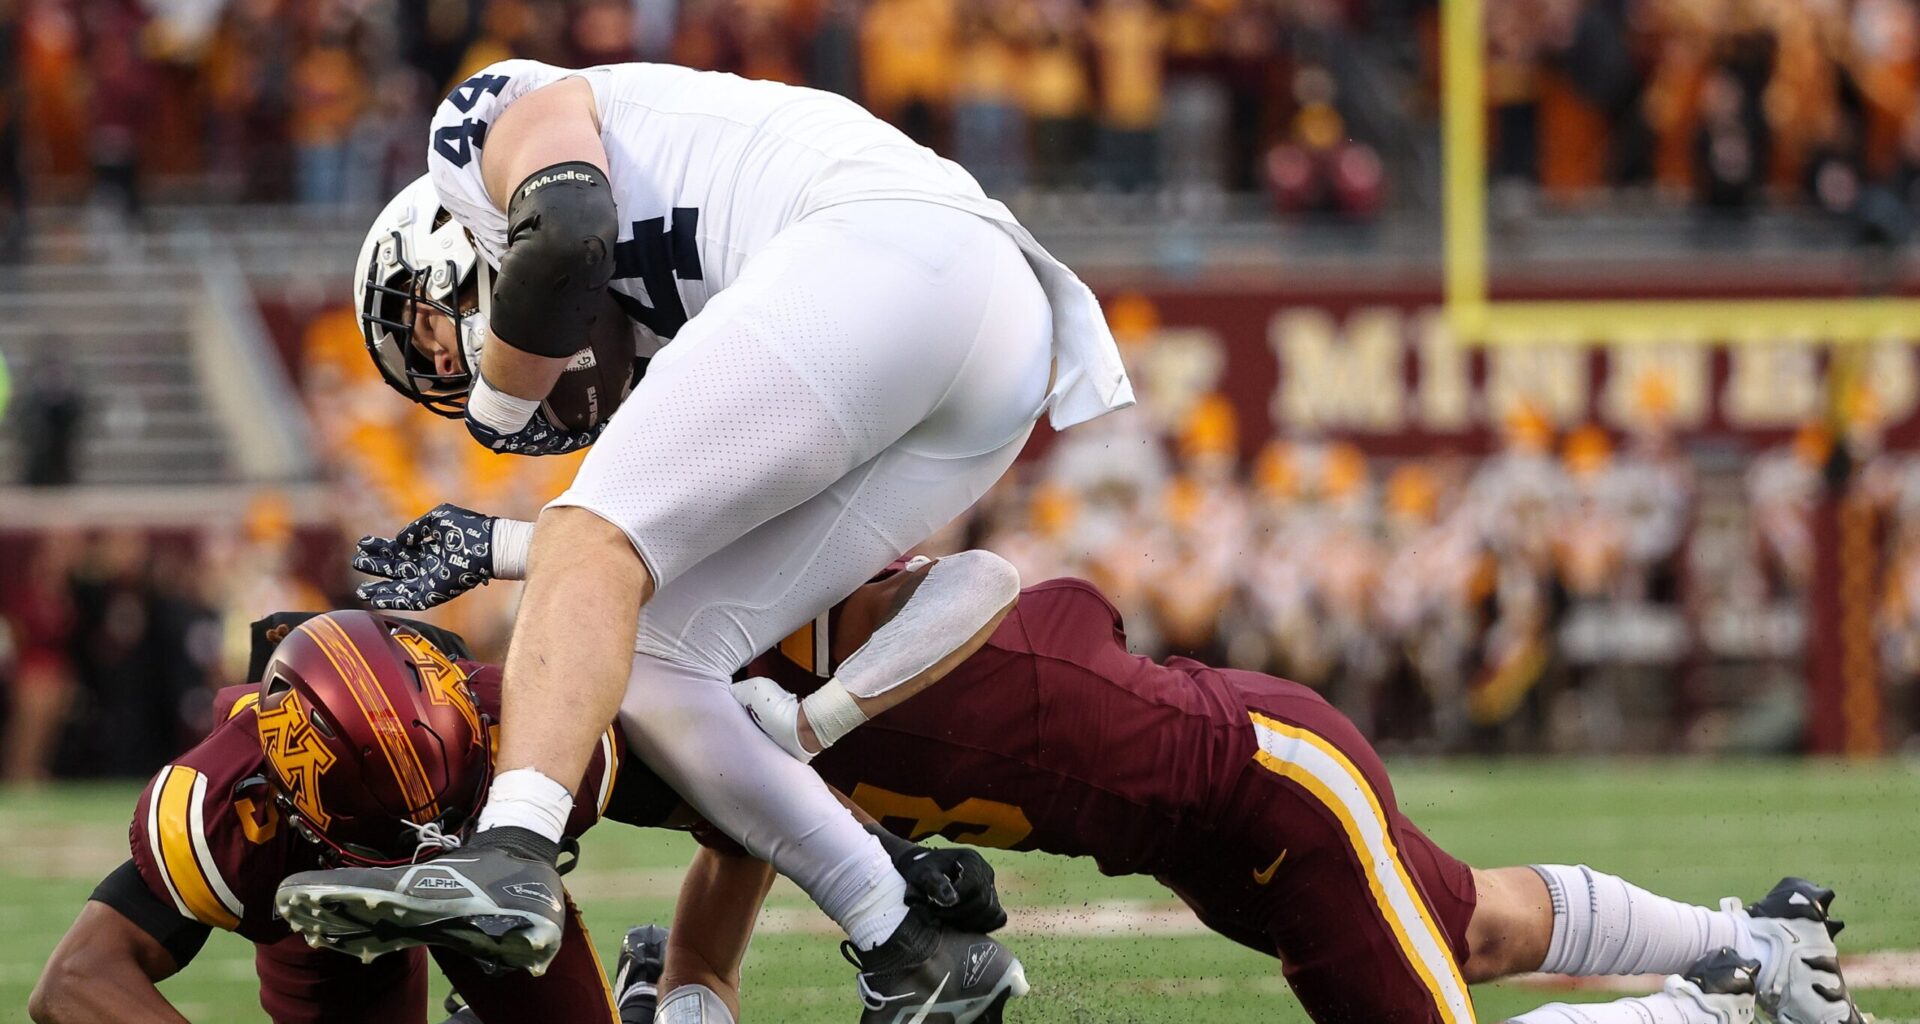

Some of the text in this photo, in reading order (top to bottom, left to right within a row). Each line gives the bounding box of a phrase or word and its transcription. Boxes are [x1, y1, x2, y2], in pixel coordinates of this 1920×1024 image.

[433, 73, 511, 170] 44
[466, 528, 482, 539] PSU
[448, 554, 471, 570] PSU
[417, 878, 464, 888] ALPHA
